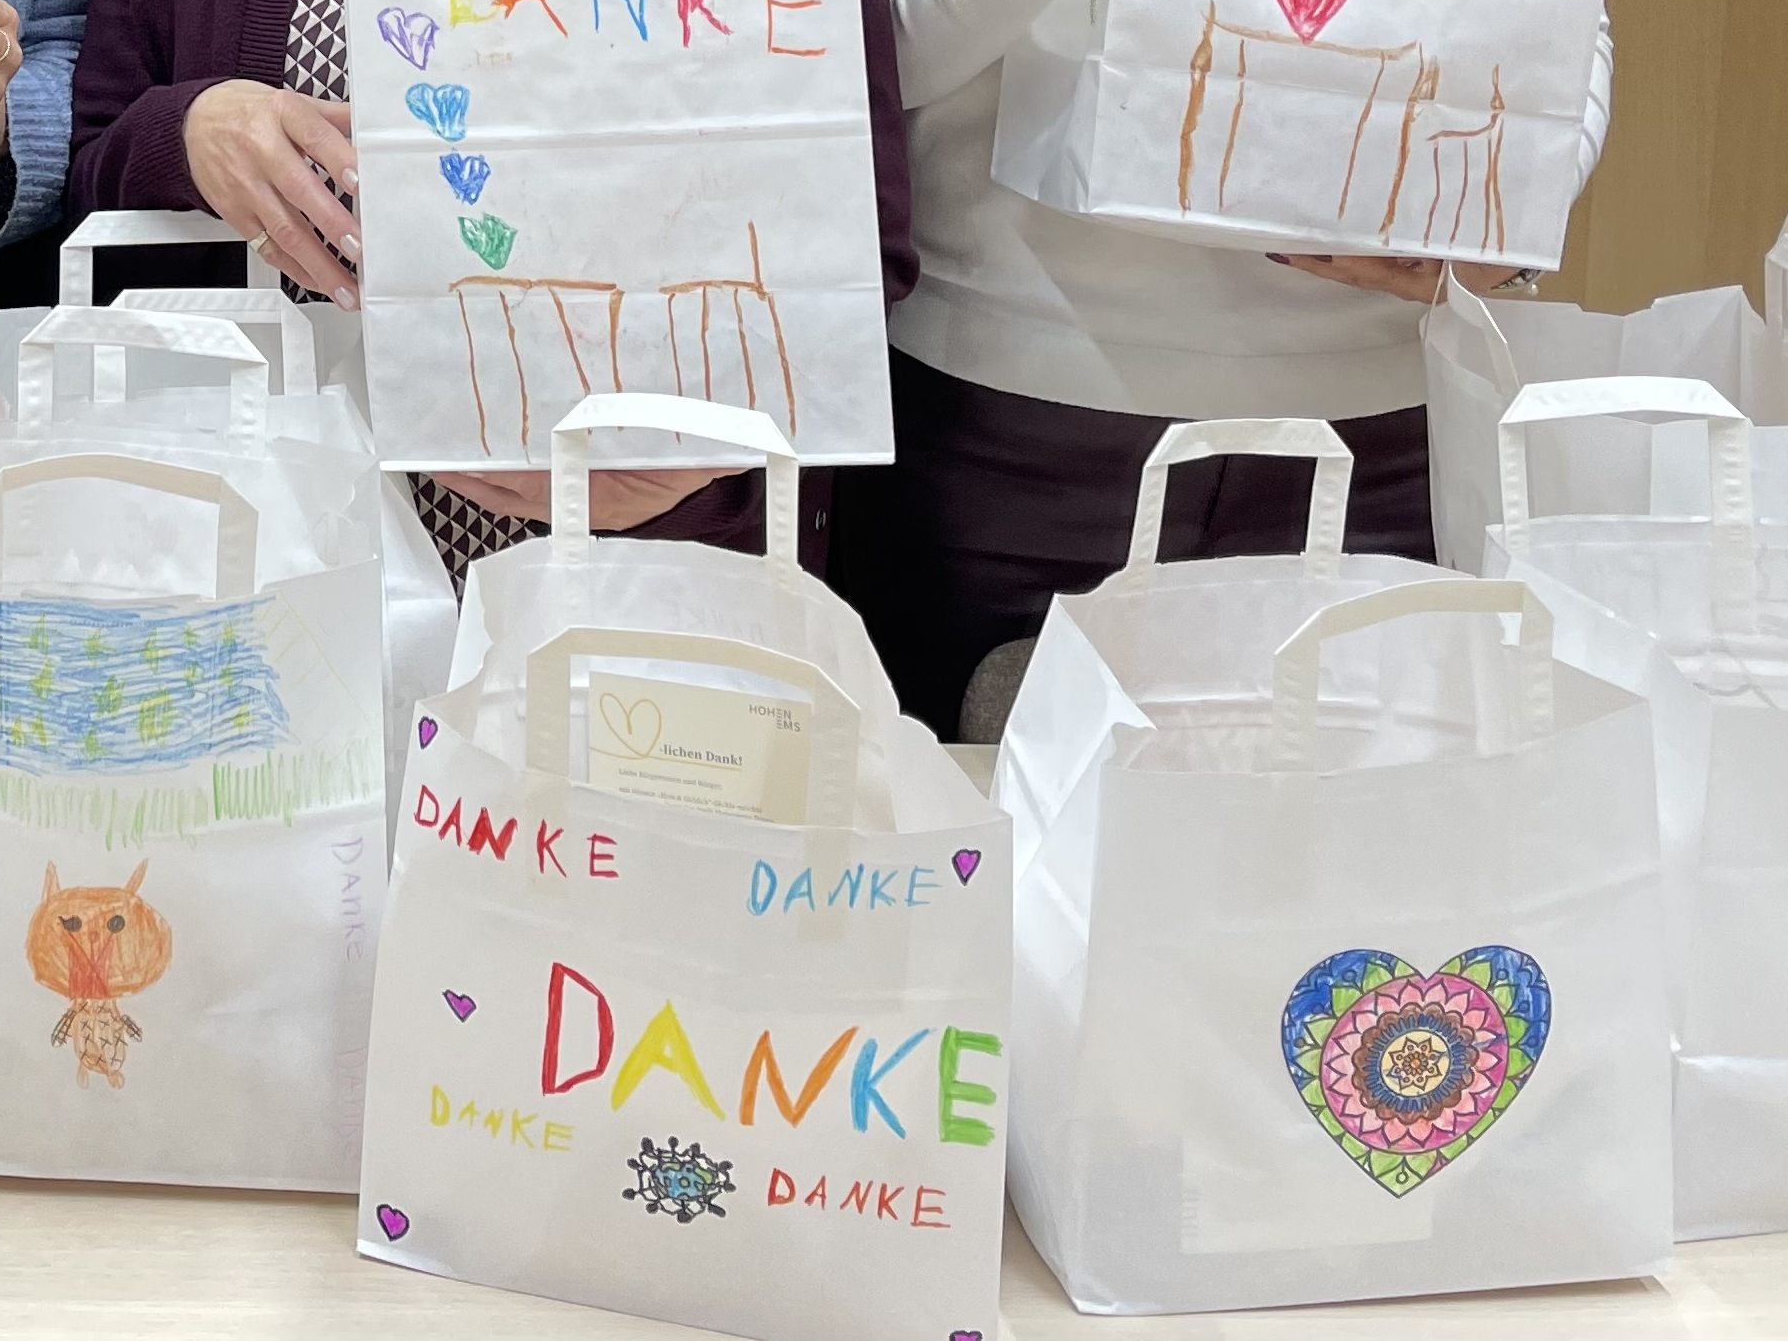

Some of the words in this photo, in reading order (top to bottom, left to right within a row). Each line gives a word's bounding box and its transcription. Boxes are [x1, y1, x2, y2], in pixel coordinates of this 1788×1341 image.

[706, 750, 743, 766] Dank!
[414, 785, 619, 879] DANKE
[746, 859, 942, 917] DANKE
[542, 962, 1004, 1146] DANKE
[430, 1085, 576, 1152] DANKE
[767, 1167, 952, 1229] DANKE
